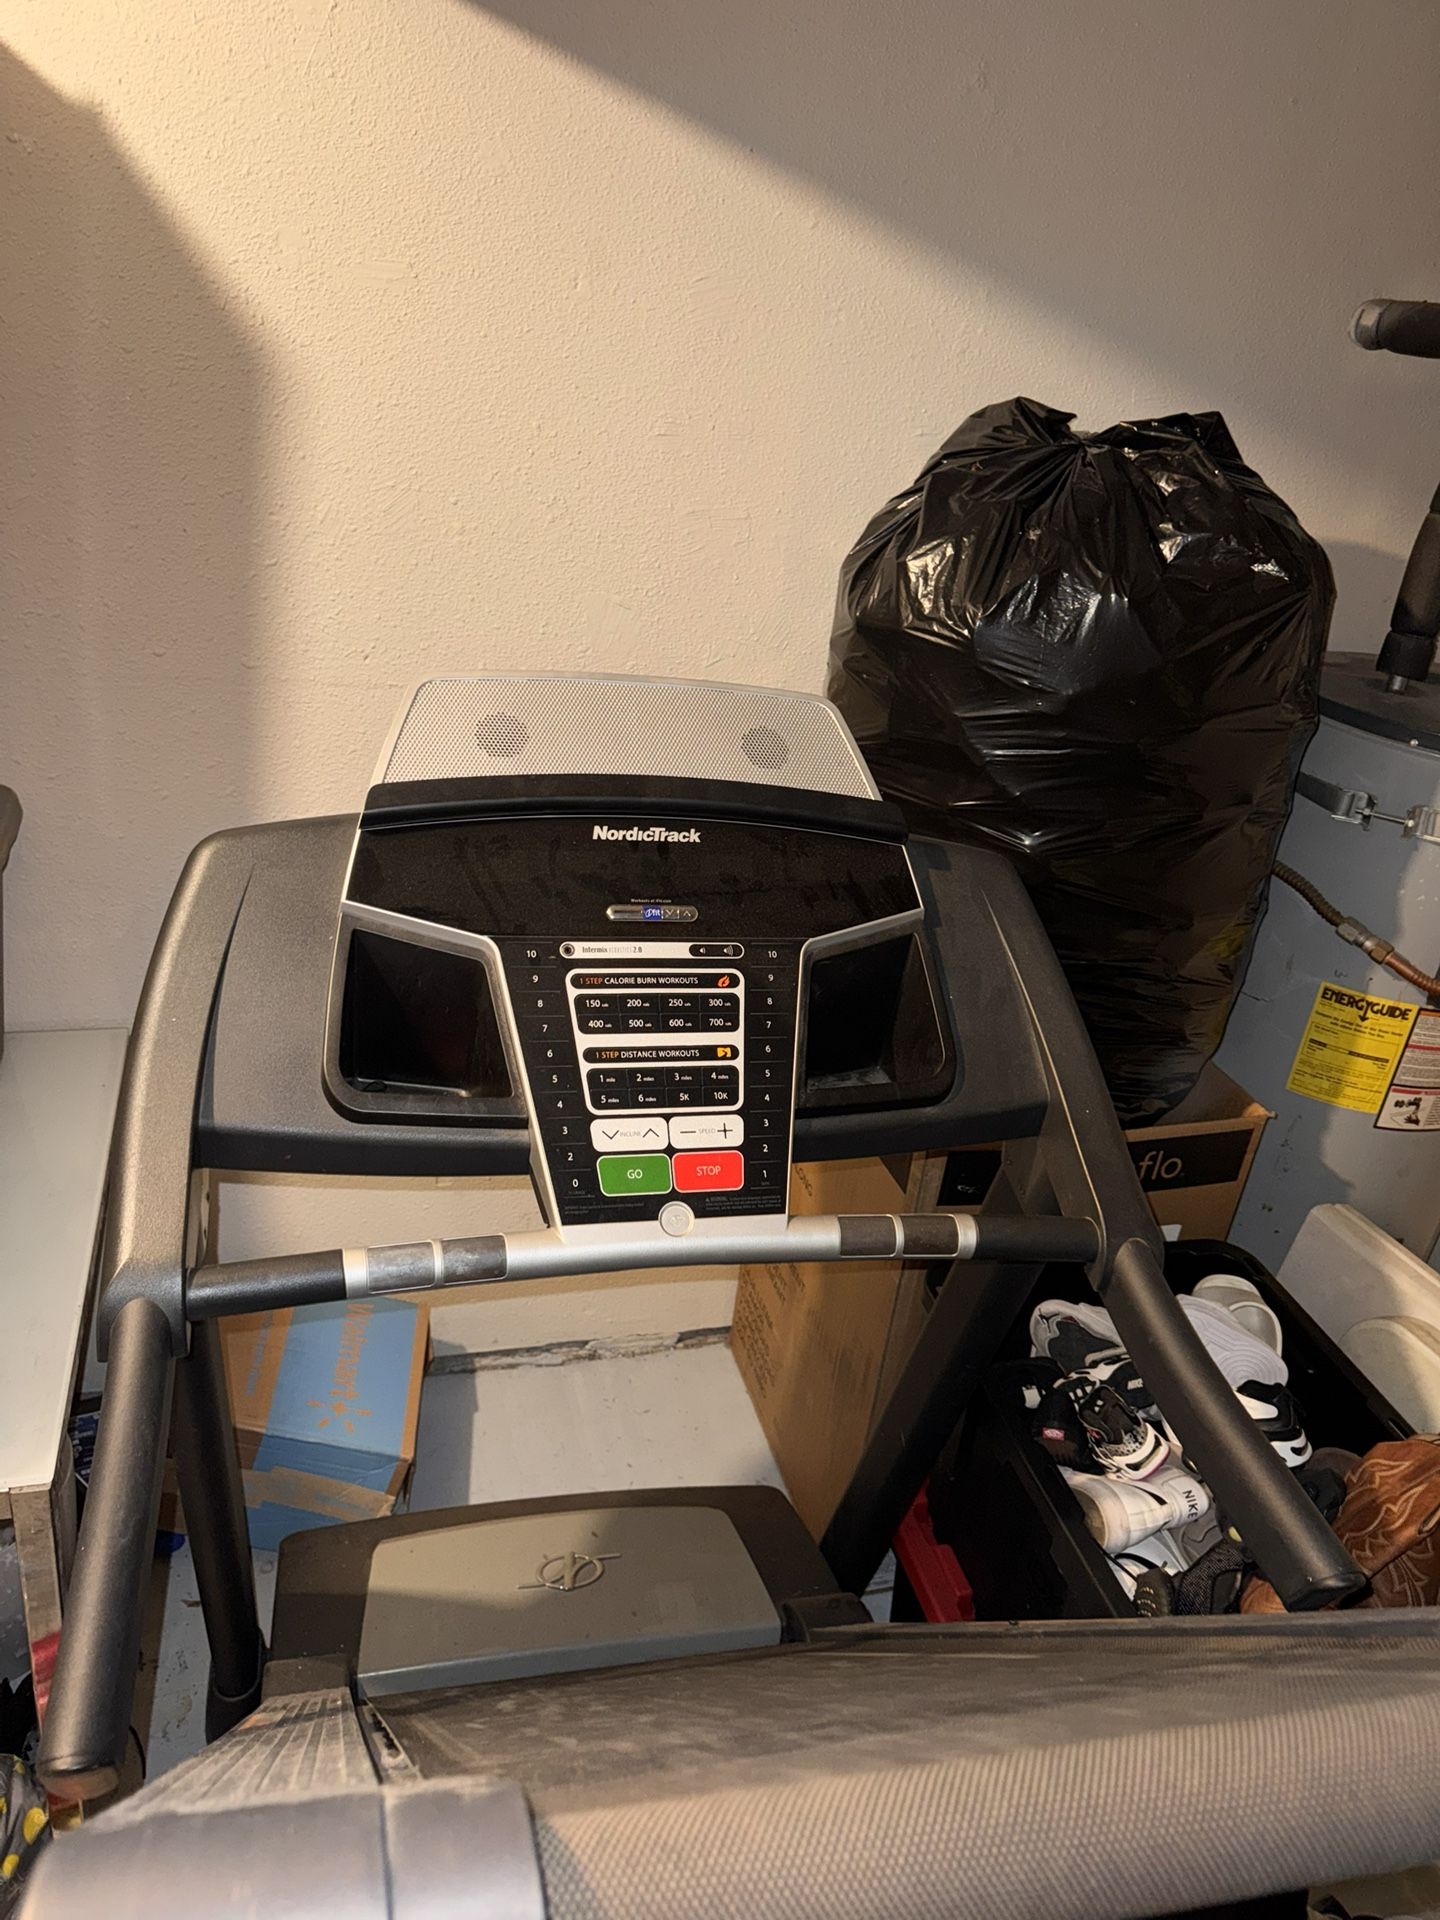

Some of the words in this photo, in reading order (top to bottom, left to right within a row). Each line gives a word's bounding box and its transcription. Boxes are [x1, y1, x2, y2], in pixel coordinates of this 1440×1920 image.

[593, 825, 701, 843] NordicTrack
[526, 950, 537, 958] 10
[532, 975, 539, 983] 9
[604, 977, 636, 985] CALORIE
[768, 974, 774, 982] 9
[537, 1000, 544, 1008] 8
[586, 1000, 601, 1008] 150
[627, 999, 642, 1007] 200
[668, 999, 684, 1007] 250
[708, 999, 723, 1007] 300
[767, 997, 773, 1005] 8
[1321, 987, 1412, 1021] ENERGYGUIDE
[588, 1020, 604, 1028] 400
[628, 1019, 644, 1028] 500
[669, 1019, 684, 1027] 600
[709, 1018, 724, 1026] 700
[766, 1021, 772, 1029] 7
[542, 1025, 548, 1033] 7
[546, 1049, 553, 1058] 6
[765, 1045, 772, 1053] 6
[601, 1051, 620, 1059] STEP
[620, 1050, 657, 1058] DISTANCE
[658, 1049, 700, 1058] WORKOUTS
[636, 1073, 642, 1082] 2
[674, 1072, 680, 1081] 3
[710, 1071, 716, 1080] 4
[765, 1069, 771, 1078] 5
[552, 1075, 558, 1083] 5
[600, 1074, 604, 1083] 1
[600, 1095, 607, 1104] 5
[638, 1094, 644, 1102] 6
[679, 1093, 690, 1101] 5K
[713, 1091, 729, 1100] 10K
[764, 1093, 770, 1102] 4
[556, 1100, 563, 1109] 4
[763, 1118, 769, 1127] 3
[562, 1126, 568, 1135] 3
[762, 1144, 769, 1153] 2
[567, 1152, 574, 1161] 2
[627, 1169, 643, 1179] GO
[696, 1165, 721, 1176] STOP
[762, 1170, 767, 1179] 1
[572, 1179, 579, 1188] 0
[329, 1303, 375, 1400] Walmart
[1182, 1489, 1199, 1520] NIKE
